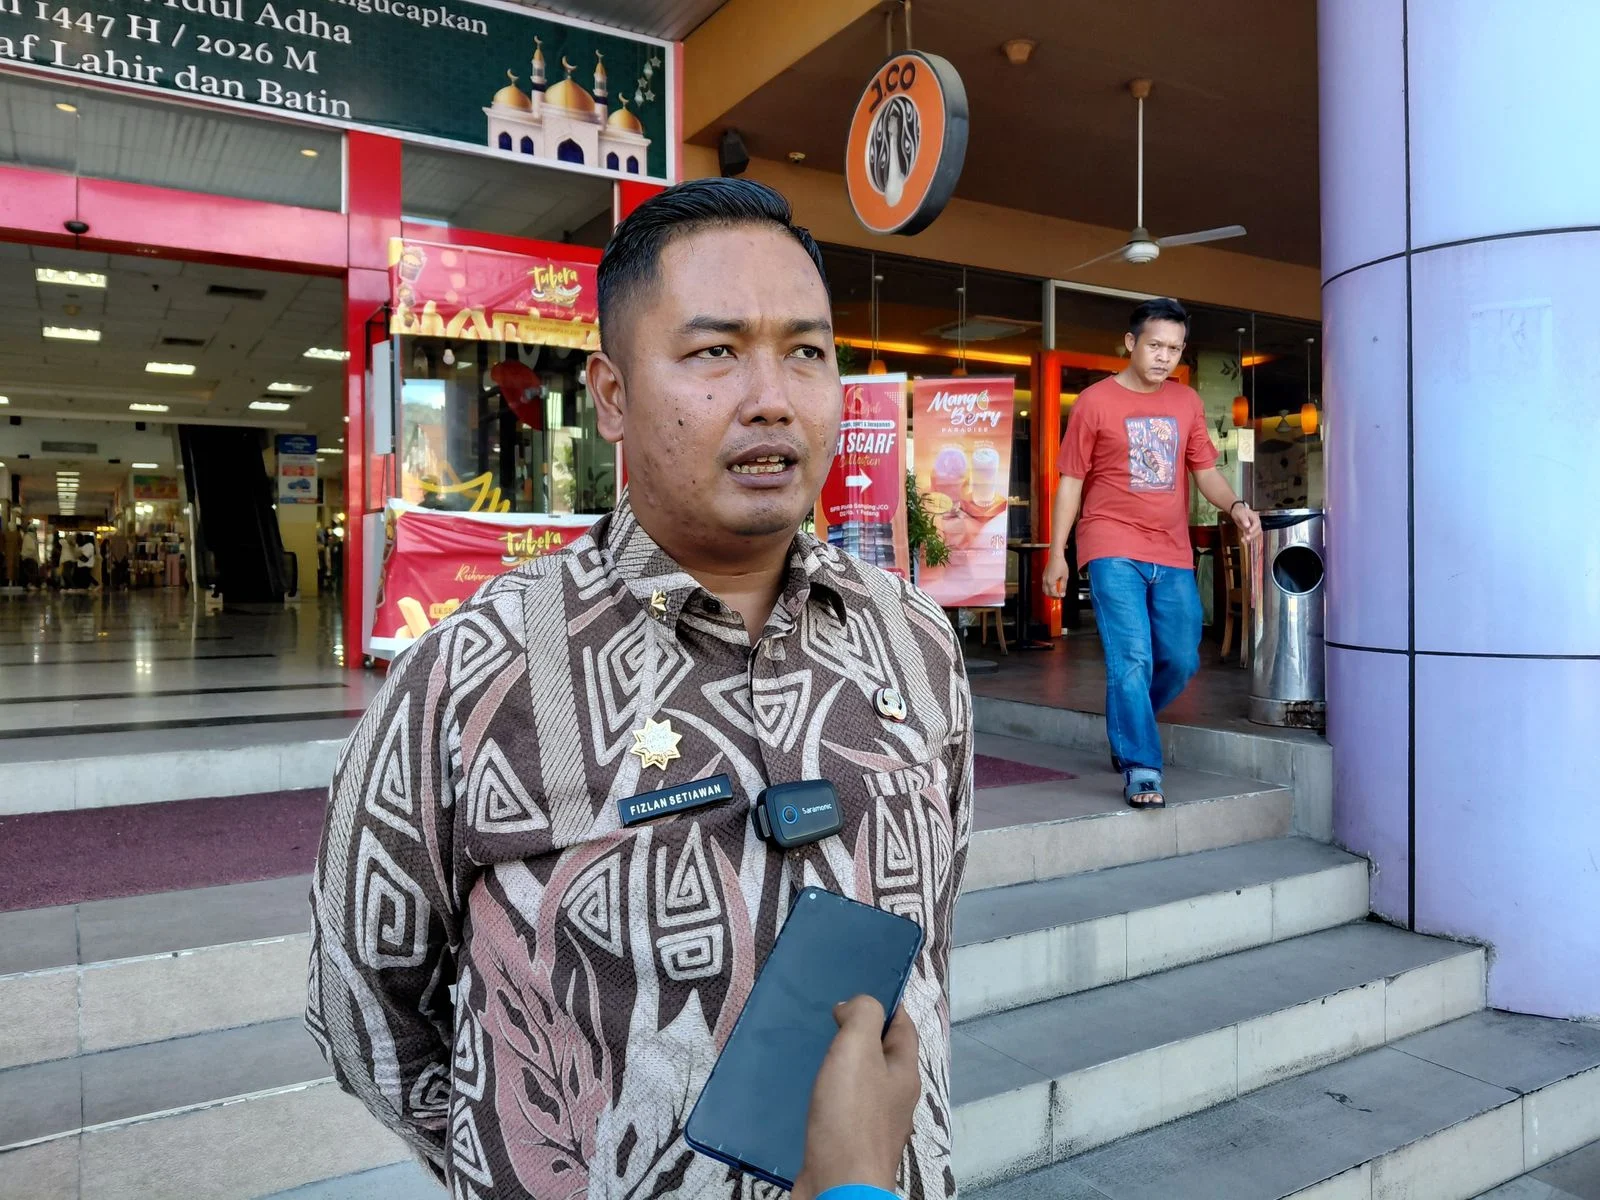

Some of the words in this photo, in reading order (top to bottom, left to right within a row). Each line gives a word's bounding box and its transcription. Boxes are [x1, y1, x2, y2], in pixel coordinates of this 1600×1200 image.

[254, 2, 352, 44] Adha
[35, 1, 116, 38] 1447
[126, 13, 161, 44] H
[171, 23, 186, 48] /
[196, 35, 274, 64] 2026
[282, 46, 319, 74] M
[50, 39, 164, 84] Lahir
[174, 65, 246, 100] dan
[257, 78, 352, 118] Batin
[527, 264, 578, 292] Tubera
[950, 407, 1001, 428] Berry
[846, 432, 897, 454] SCARF
[498, 528, 562, 556] Tubera
[630, 798, 668, 816] FIZLAN
[669, 783, 722, 806] SETIAWAN
[802, 803, 832, 815] Saramonic
